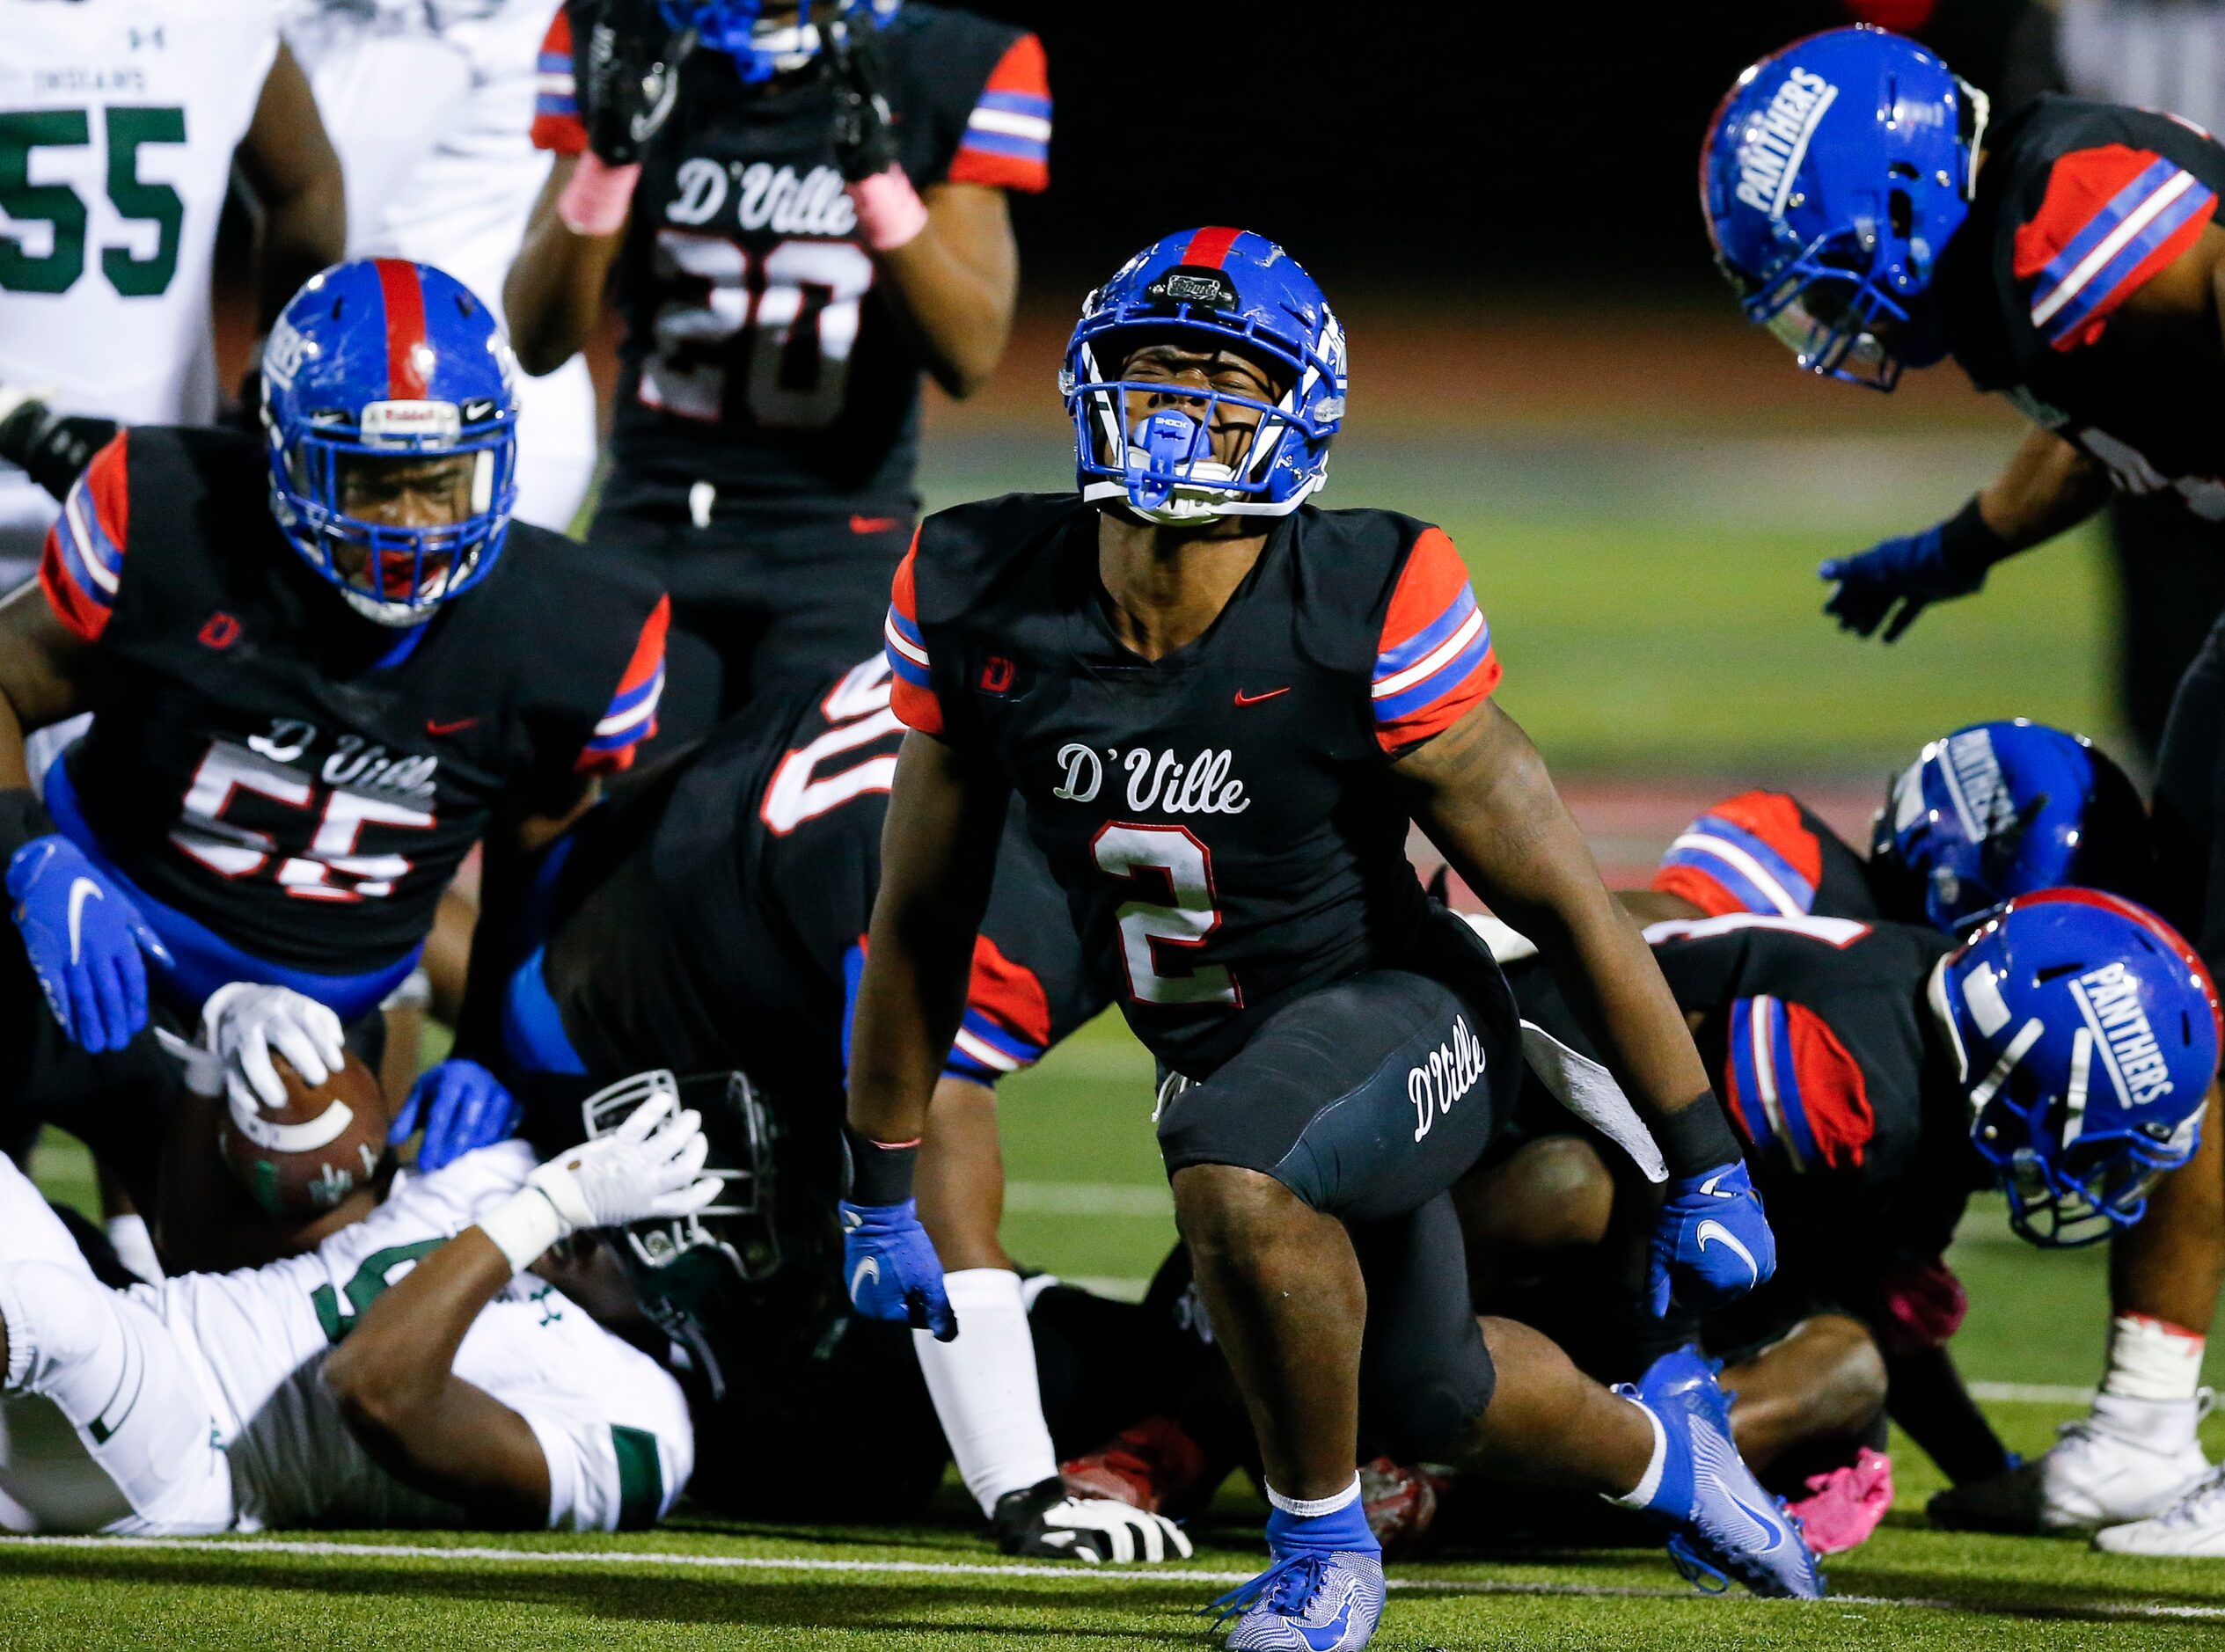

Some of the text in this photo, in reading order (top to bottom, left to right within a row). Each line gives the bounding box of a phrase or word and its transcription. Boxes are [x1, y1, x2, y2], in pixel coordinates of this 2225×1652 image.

[0, 106, 187, 297] 55
[665, 157, 859, 236] D'Ville
[1736, 66, 1827, 214] PANTHERS
[640, 229, 875, 426] 20
[1053, 742, 1251, 815] D'Ville
[1088, 819, 1245, 1010] 2
[1408, 1013, 1487, 1144] D'Ville
[2080, 961, 2175, 1106] PANTHERS
